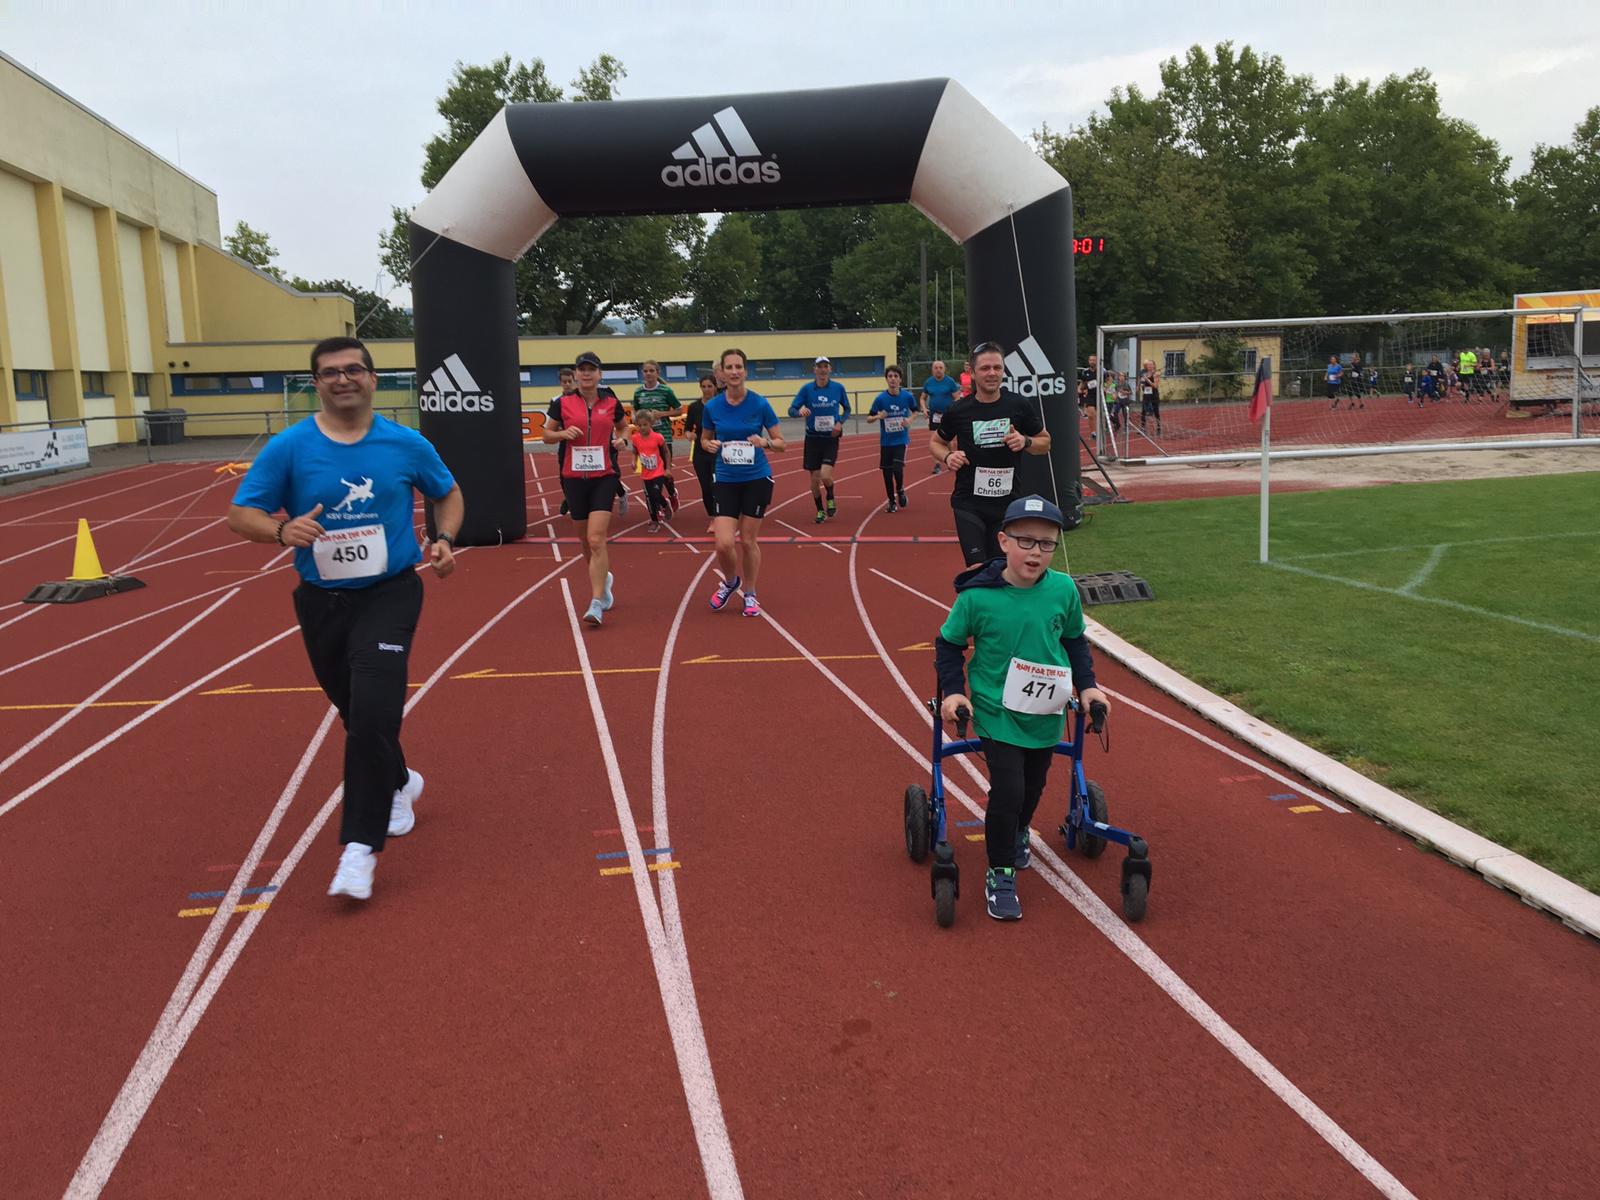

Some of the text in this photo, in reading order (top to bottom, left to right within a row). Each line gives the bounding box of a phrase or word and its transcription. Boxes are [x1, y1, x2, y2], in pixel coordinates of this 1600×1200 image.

[661, 156, 781, 187] adidas
[1000, 374, 1066, 397] didas
[419, 391, 495, 412] adidas
[581, 454, 594, 463] 73
[732, 448, 744, 457] 70
[977, 487, 1010, 496] Christian
[988, 478, 1002, 488] 66
[332, 544, 369, 564] 450
[1022, 680, 1056, 700] 471
